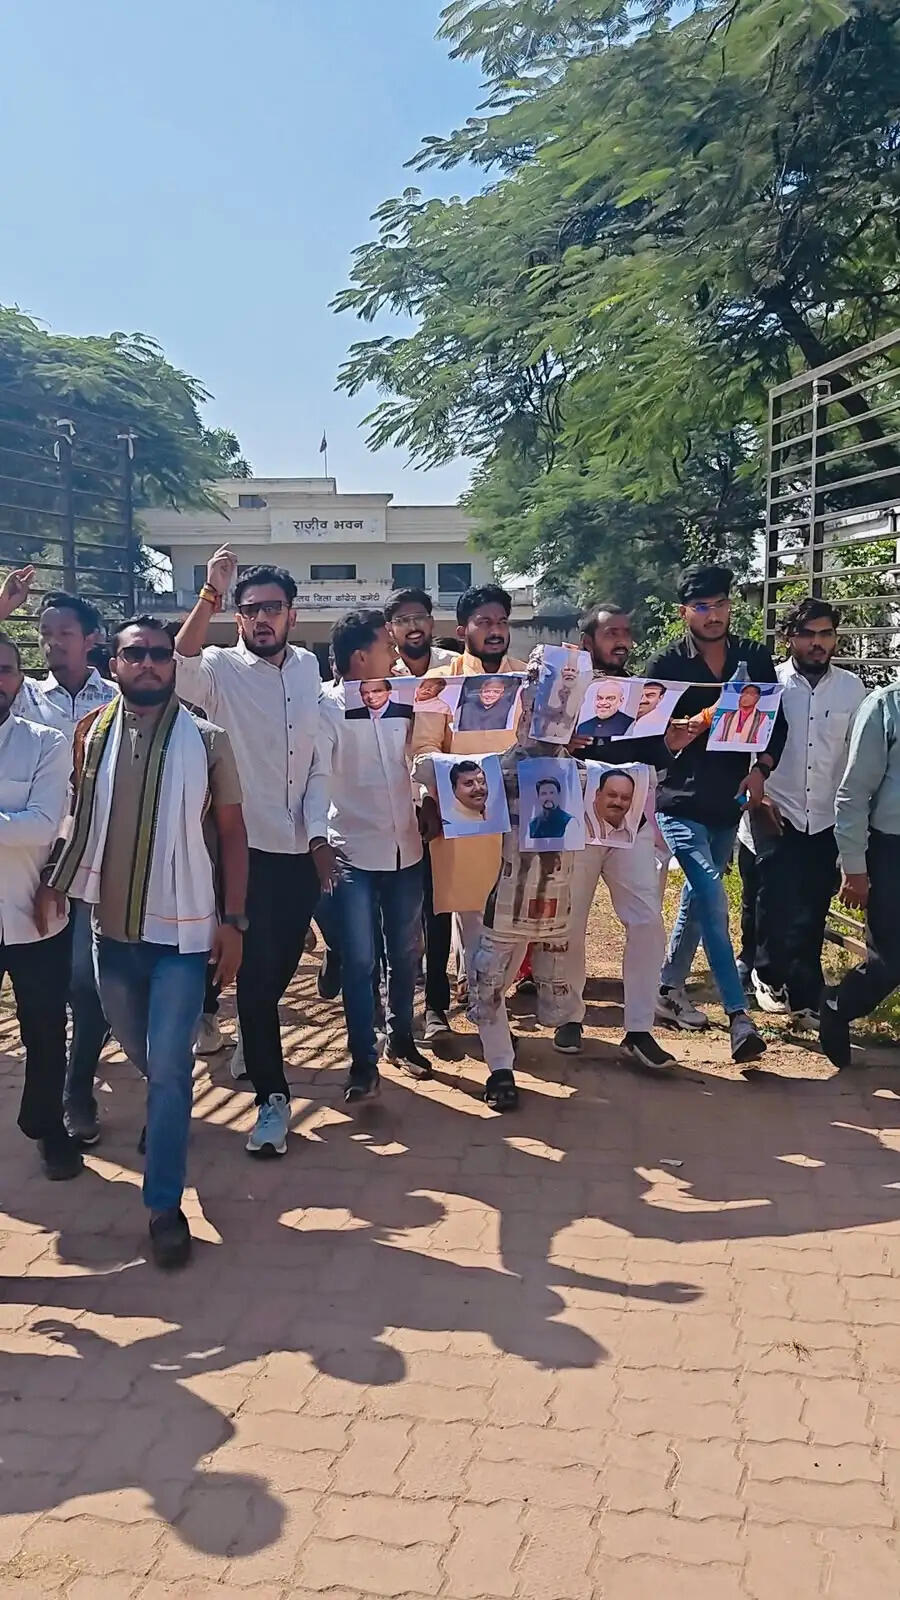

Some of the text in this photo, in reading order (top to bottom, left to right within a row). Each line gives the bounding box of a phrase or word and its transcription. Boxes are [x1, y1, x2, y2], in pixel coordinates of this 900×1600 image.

[292, 517, 364, 530] राजीव भवन
[313, 593, 332, 602] जिला
